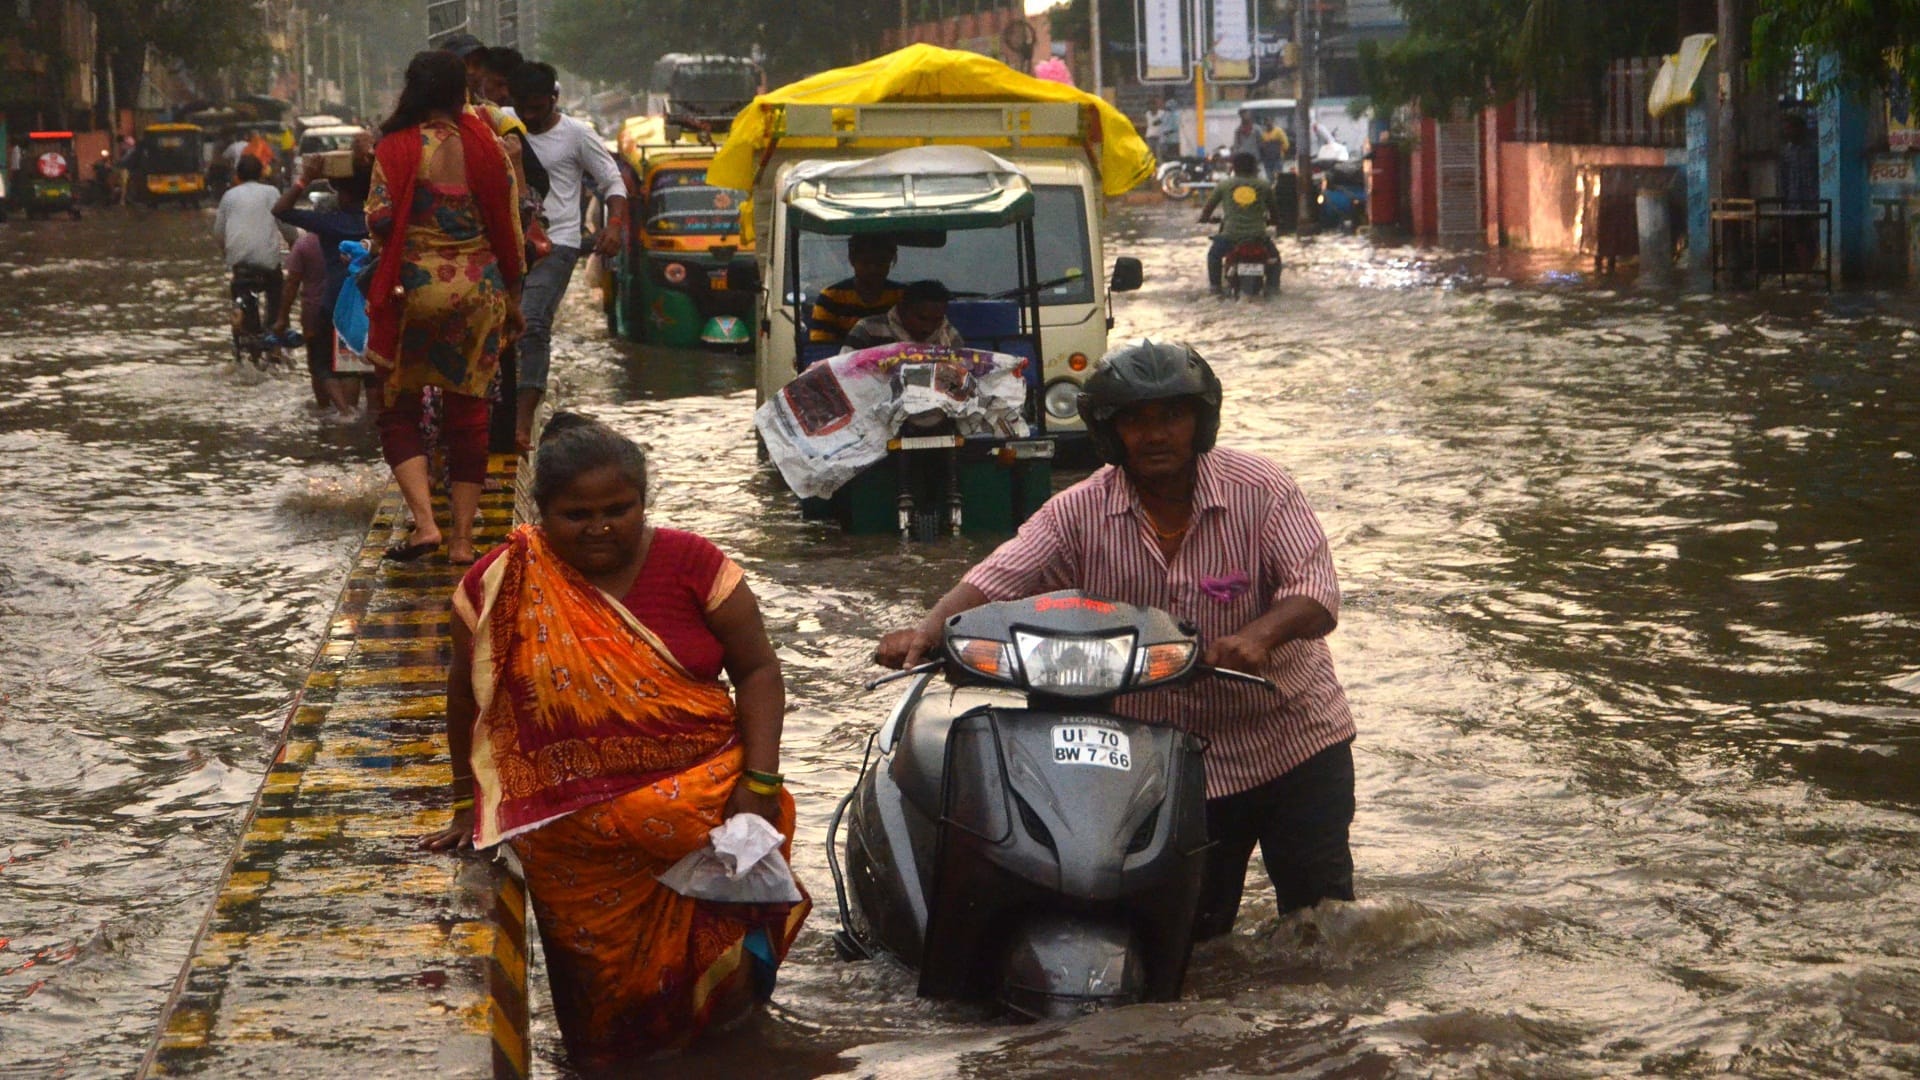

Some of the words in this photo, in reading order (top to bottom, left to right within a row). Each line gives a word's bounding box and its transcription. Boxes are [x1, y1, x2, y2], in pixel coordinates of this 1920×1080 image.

[1062, 716, 1120, 728] HONDA
[1098, 730, 1119, 746] 70
[1055, 747, 1080, 761] BW
[1087, 748, 1129, 768] 766
